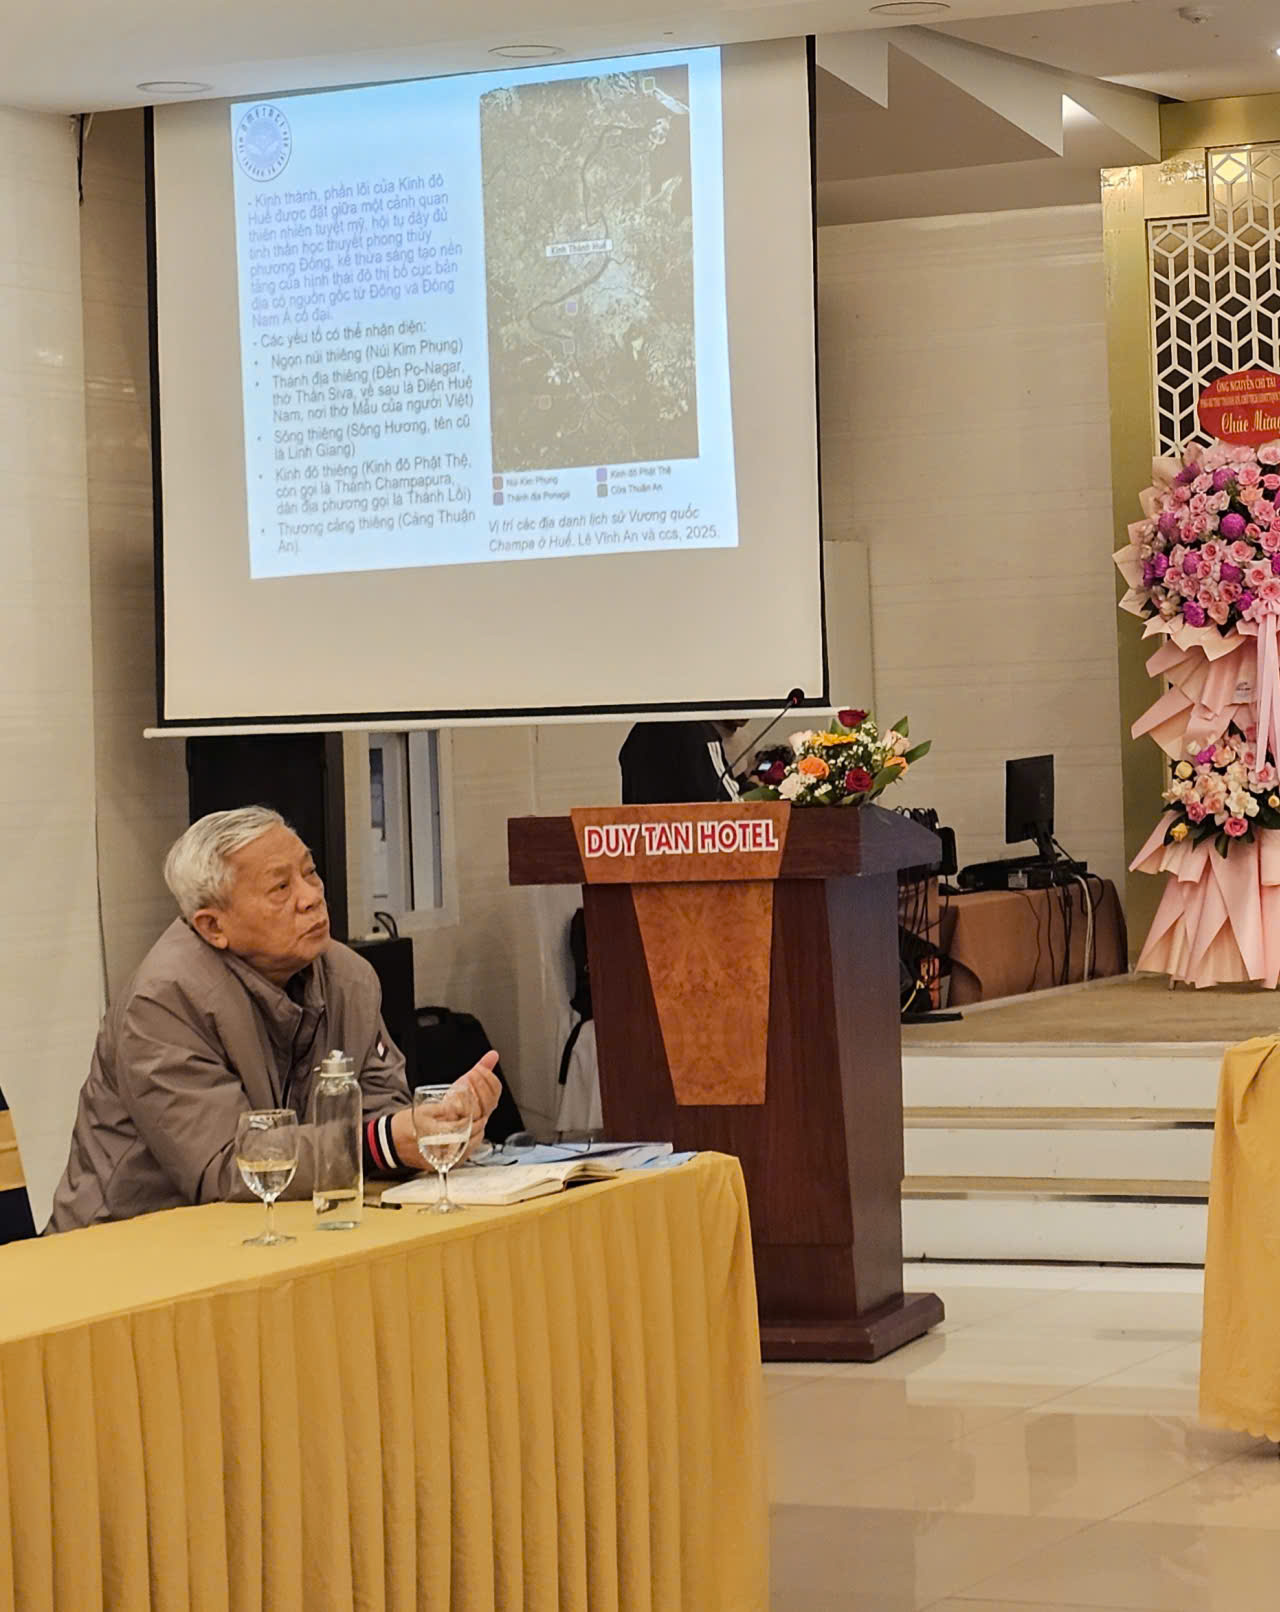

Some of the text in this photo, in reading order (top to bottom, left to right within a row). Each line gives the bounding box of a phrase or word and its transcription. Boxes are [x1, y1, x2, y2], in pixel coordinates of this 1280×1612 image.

[260, 335, 284, 347] Các
[271, 357, 301, 370] Ngọn
[393, 344, 415, 356] Kim
[378, 384, 398, 393] sau
[381, 399, 402, 411] của
[274, 430, 303, 443] Sông
[308, 426, 342, 440] thiêng
[434, 417, 452, 428] tên
[288, 446, 311, 458] Linh
[316, 442, 355, 457] Giang)
[275, 467, 300, 480] Kinh
[558, 514, 585, 526] danh
[589, 512, 607, 526] lịch
[629, 510, 666, 523] Vương
[586, 820, 778, 857] DUY TAN HOTEL
